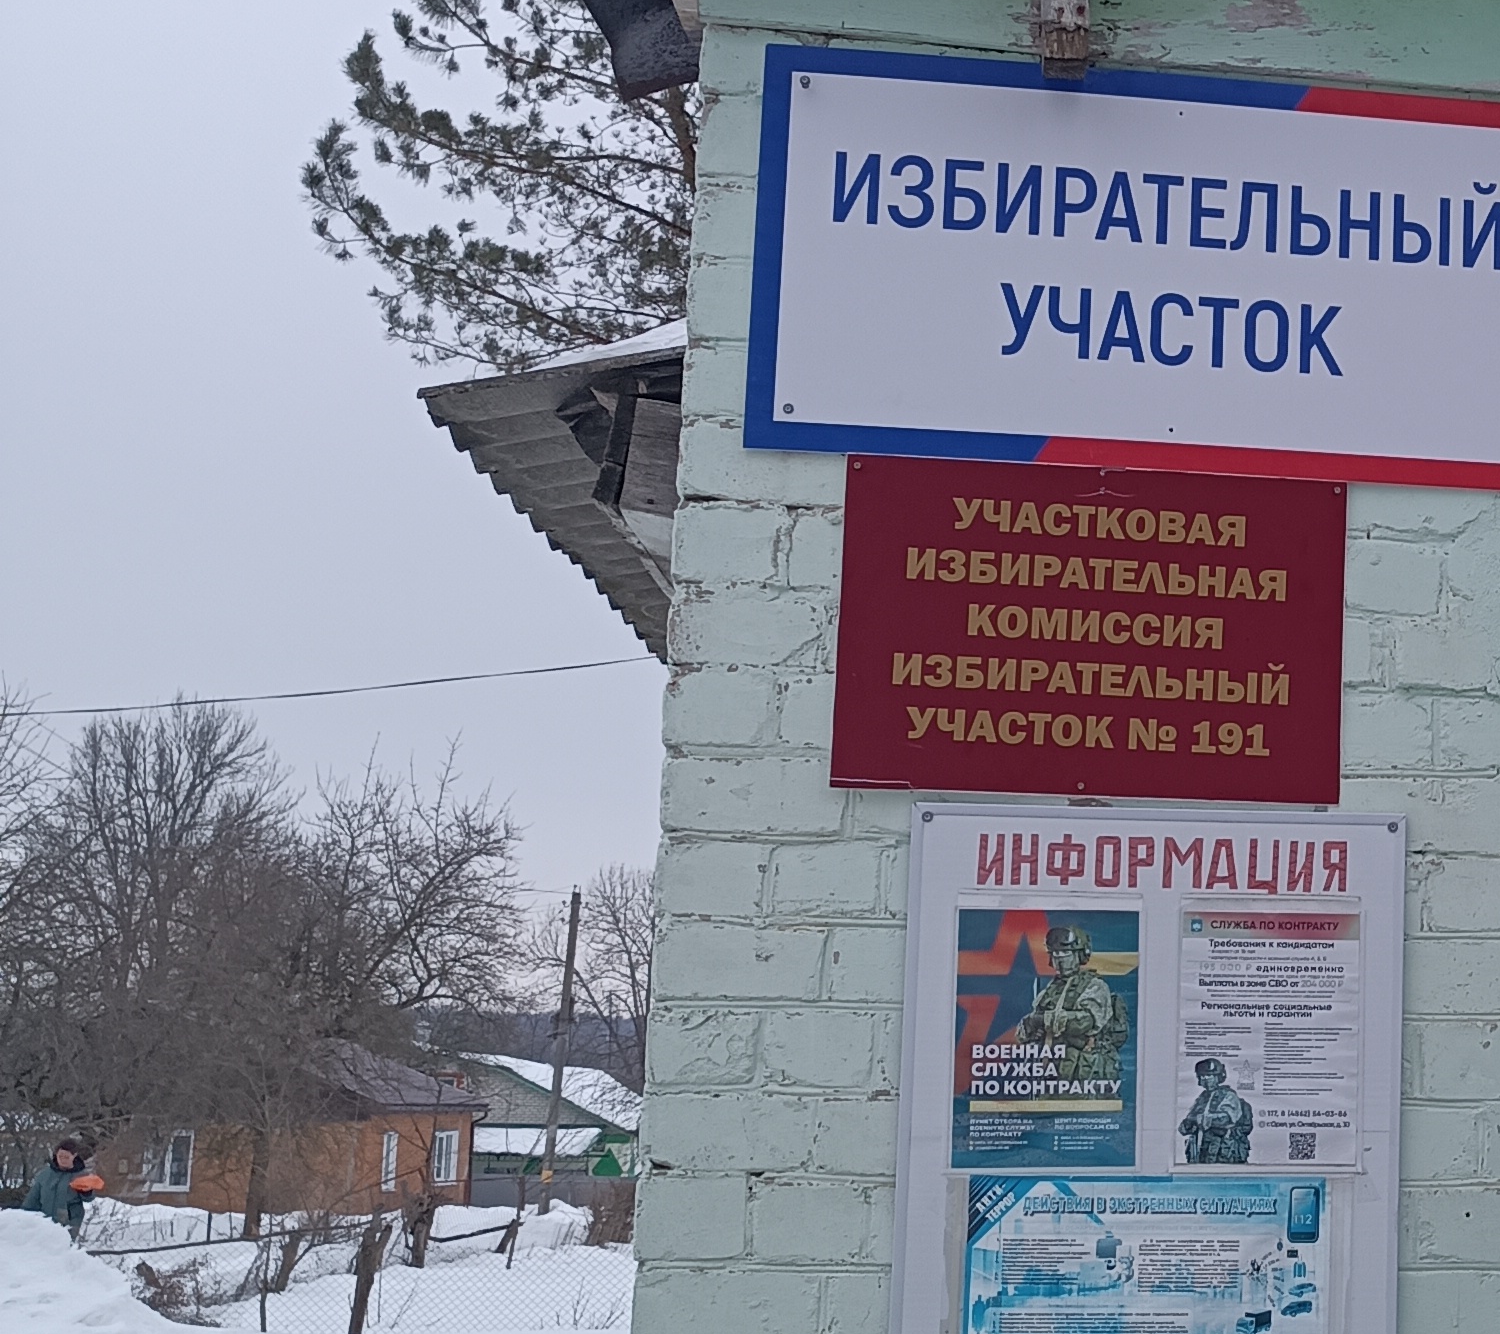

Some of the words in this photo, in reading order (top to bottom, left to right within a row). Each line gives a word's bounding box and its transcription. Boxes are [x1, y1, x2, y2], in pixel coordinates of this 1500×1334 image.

[1000, 281, 1344, 377] УЧАСТОК
[952, 496, 1247, 548] УЧАСТКОВАЯ
[905, 546, 1288, 602] ИЗБИРАТЕЛЬНАЯ
[966, 603, 1225, 650] КОМИССИЯ
[891, 652, 1291, 706] ИЗБИРАТЕЛЬНЫЙ
[905, 706, 1114, 750] УЧАСТОК
[1127, 717, 1178, 752] №
[1190, 720, 1271, 757] 191
[976, 832, 1349, 896] ИНФОРМАЦИЯ
[1210, 920, 1257, 931] СЛУЖБА
[1259, 920, 1276, 931] ПО
[1278, 920, 1340, 932] КОНТРАКТУ
[1208, 938, 1266, 949] Требования
[1276, 941, 1335, 950] кандидатам
[1268, 979, 1288, 988] СВО
[1201, 1002, 1271, 1011] Региональные
[1273, 1003, 1332, 1012] социальные
[971, 1044, 1067, 1060] ВОЕННАЯ
[971, 1062, 1058, 1078] СЛУЖБА
[970, 1080, 999, 1096] ПО
[1003, 1080, 1122, 1096] КОНТРАКТУ
[985, 1191, 1016, 1222] ТЕРРОР
[1022, 1194, 1094, 1216] ДЕЙСТВИЯ
[1096, 1196, 1107, 1214] В
[1108, 1195, 1198, 1215] ЭКСТРЕННЫХ
[1199, 1196, 1278, 1218] СИТУАЦИЯХ
[1294, 1214, 1313, 1225] 112
